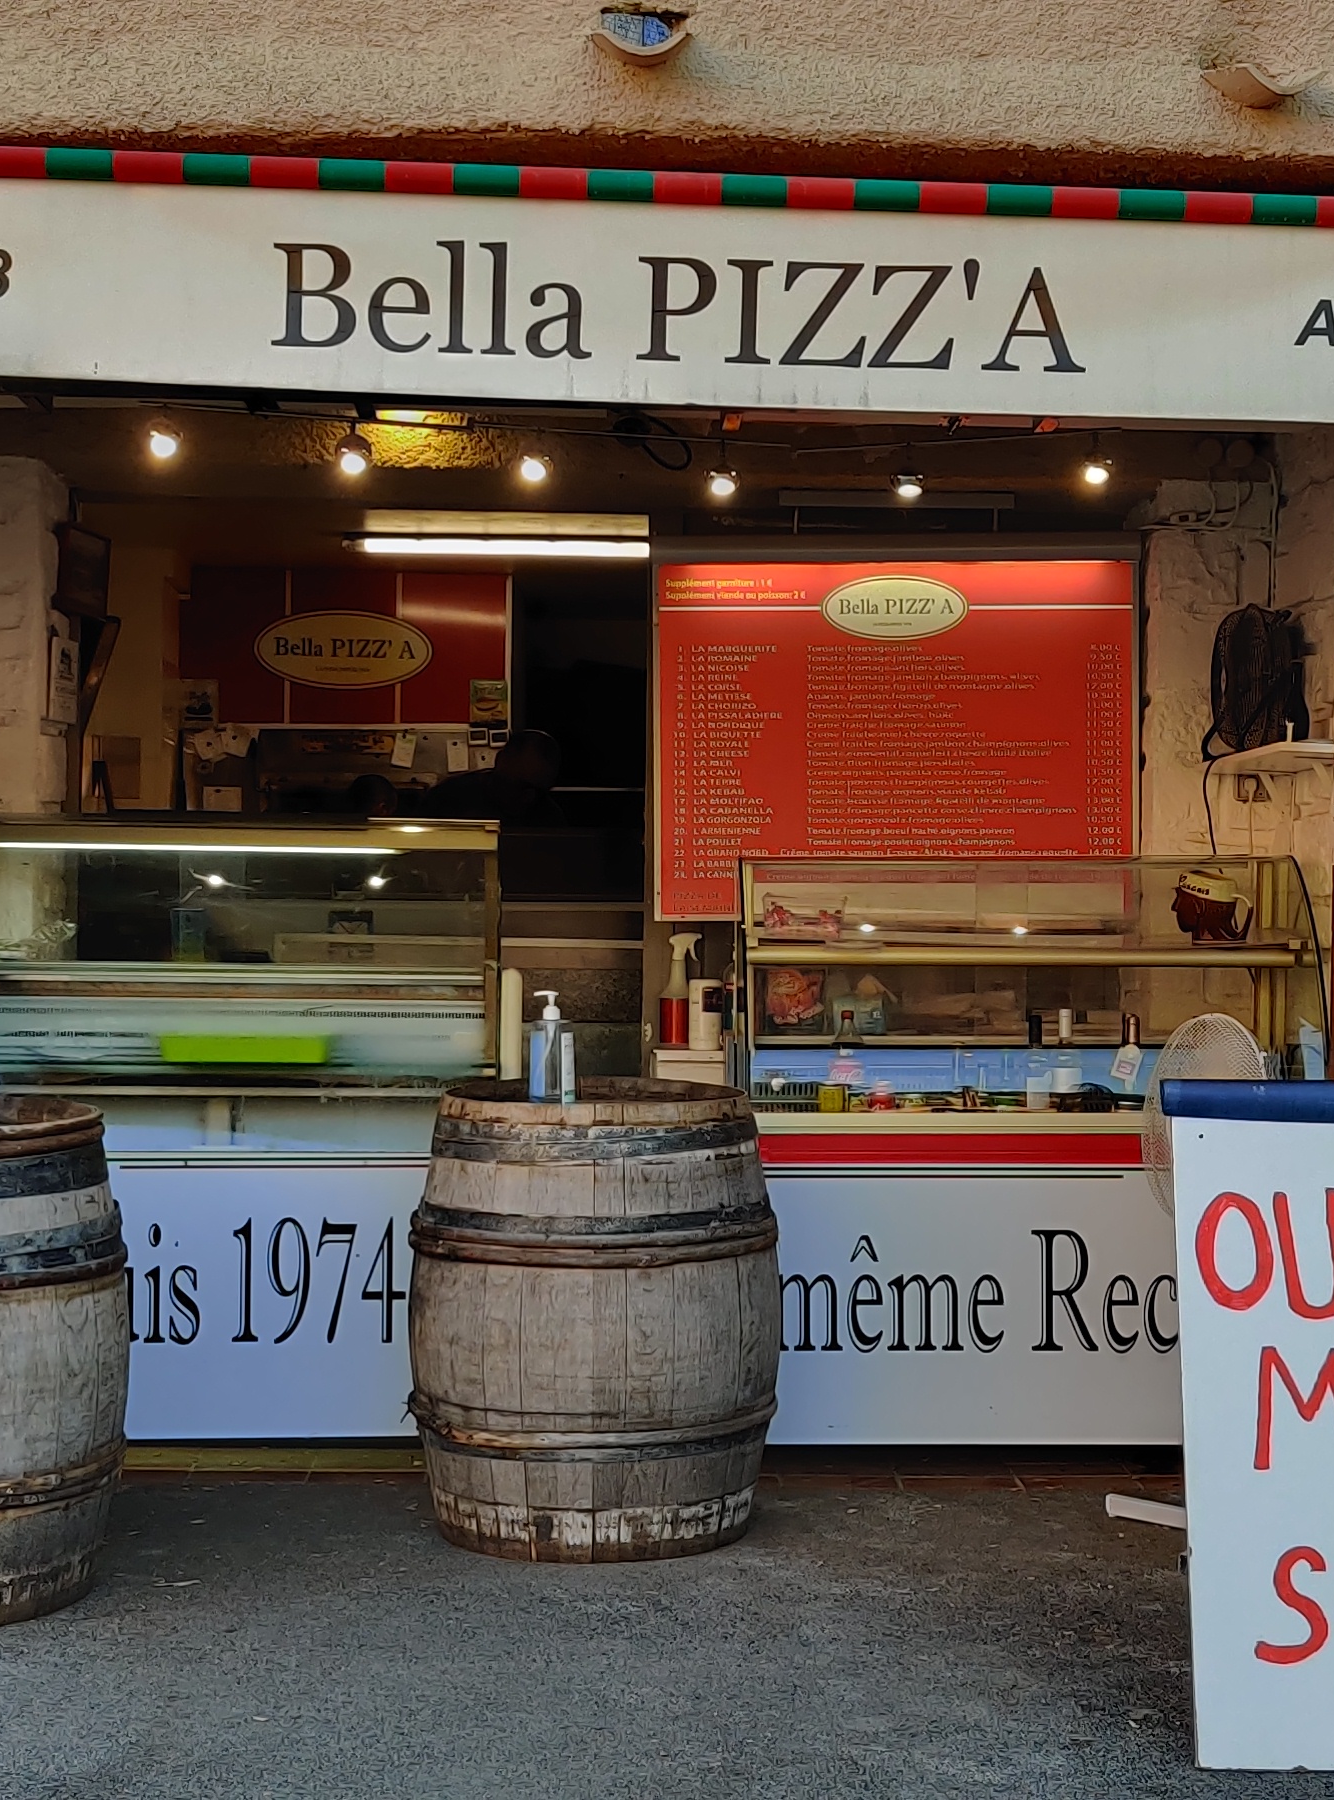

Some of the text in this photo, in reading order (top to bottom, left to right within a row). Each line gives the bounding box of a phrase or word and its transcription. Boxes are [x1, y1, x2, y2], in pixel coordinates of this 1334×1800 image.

[270, 240, 1087, 373] Bella PIZZ'A
[838, 598, 879, 615] Bella
[273, 636, 324, 658] Bella
[691, 645, 778, 653] LA MARGUERITE
[691, 655, 705, 663] LA
[708, 655, 759, 663] ROMAINE
[691, 664, 705, 672] LA
[691, 674, 705, 682] LA
[708, 674, 739, 682] REINE
[691, 684, 705, 692] LA
[708, 684, 742, 692] CORSE
[691, 693, 705, 701] LA
[691, 703, 757, 711] LA CHORIZO
[691, 712, 705, 720] LA
[691, 722, 705, 730] LA
[708, 722, 766, 730] NORDIQUE
[693, 731, 707, 739] LA
[710, 731, 762, 739] BIQUETTE
[693, 740, 751, 748] LA ROYALE
[693, 750, 707, 758] LA
[710, 750, 750, 758] CHEESE
[693, 760, 707, 768] LA
[693, 769, 741, 777] LA CALVI
[693, 778, 742, 786] LA TERRE
[693, 788, 707, 796] LA
[710, 788, 746, 796] KEBAB
[693, 798, 708, 806] LA
[693, 806, 707, 815] LA
[693, 816, 706, 824] LA
[707, 816, 772, 824] GORGONZOLA
[692, 838, 742, 846] LA POULET
[693, 848, 705, 857] LA
[707, 848, 740, 857] GRAND
[693, 860, 706, 868] LA
[693, 870, 706, 879] LA
[231, 1216, 407, 1345] 1974
[779, 1234, 1005, 1354] même
